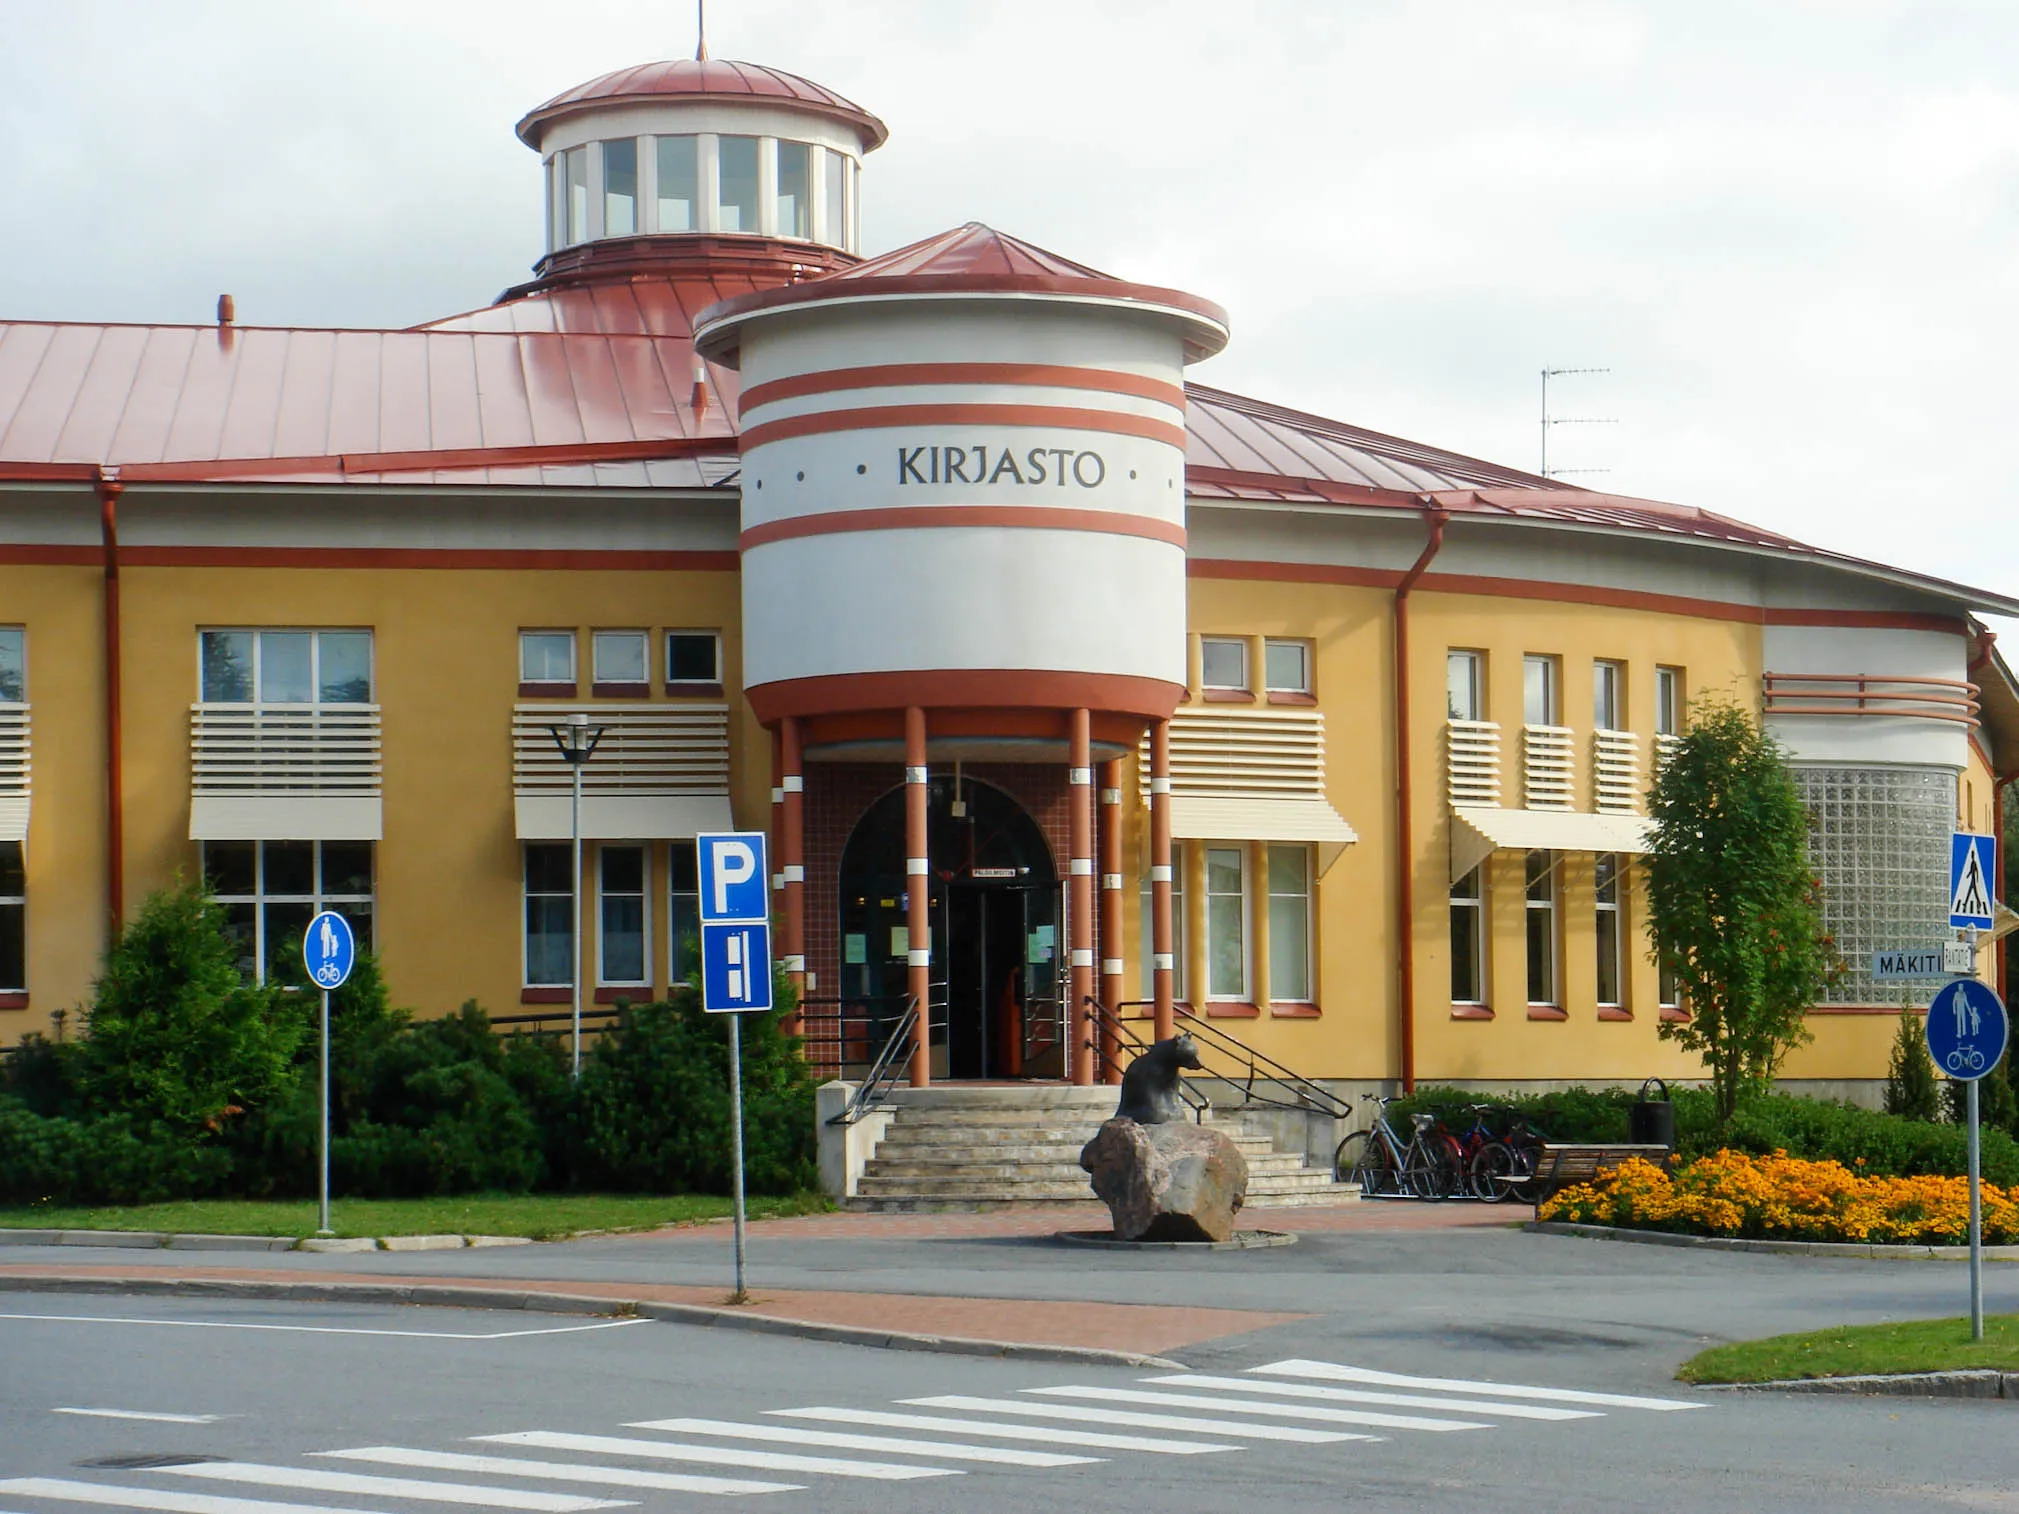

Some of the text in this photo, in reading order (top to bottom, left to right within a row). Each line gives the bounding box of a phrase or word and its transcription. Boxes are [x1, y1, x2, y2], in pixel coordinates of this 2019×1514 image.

[899, 446, 1105, 488] KIRJASTO
[712, 841, 756, 914] P
[1880, 953, 1942, 974] MÄKITI
